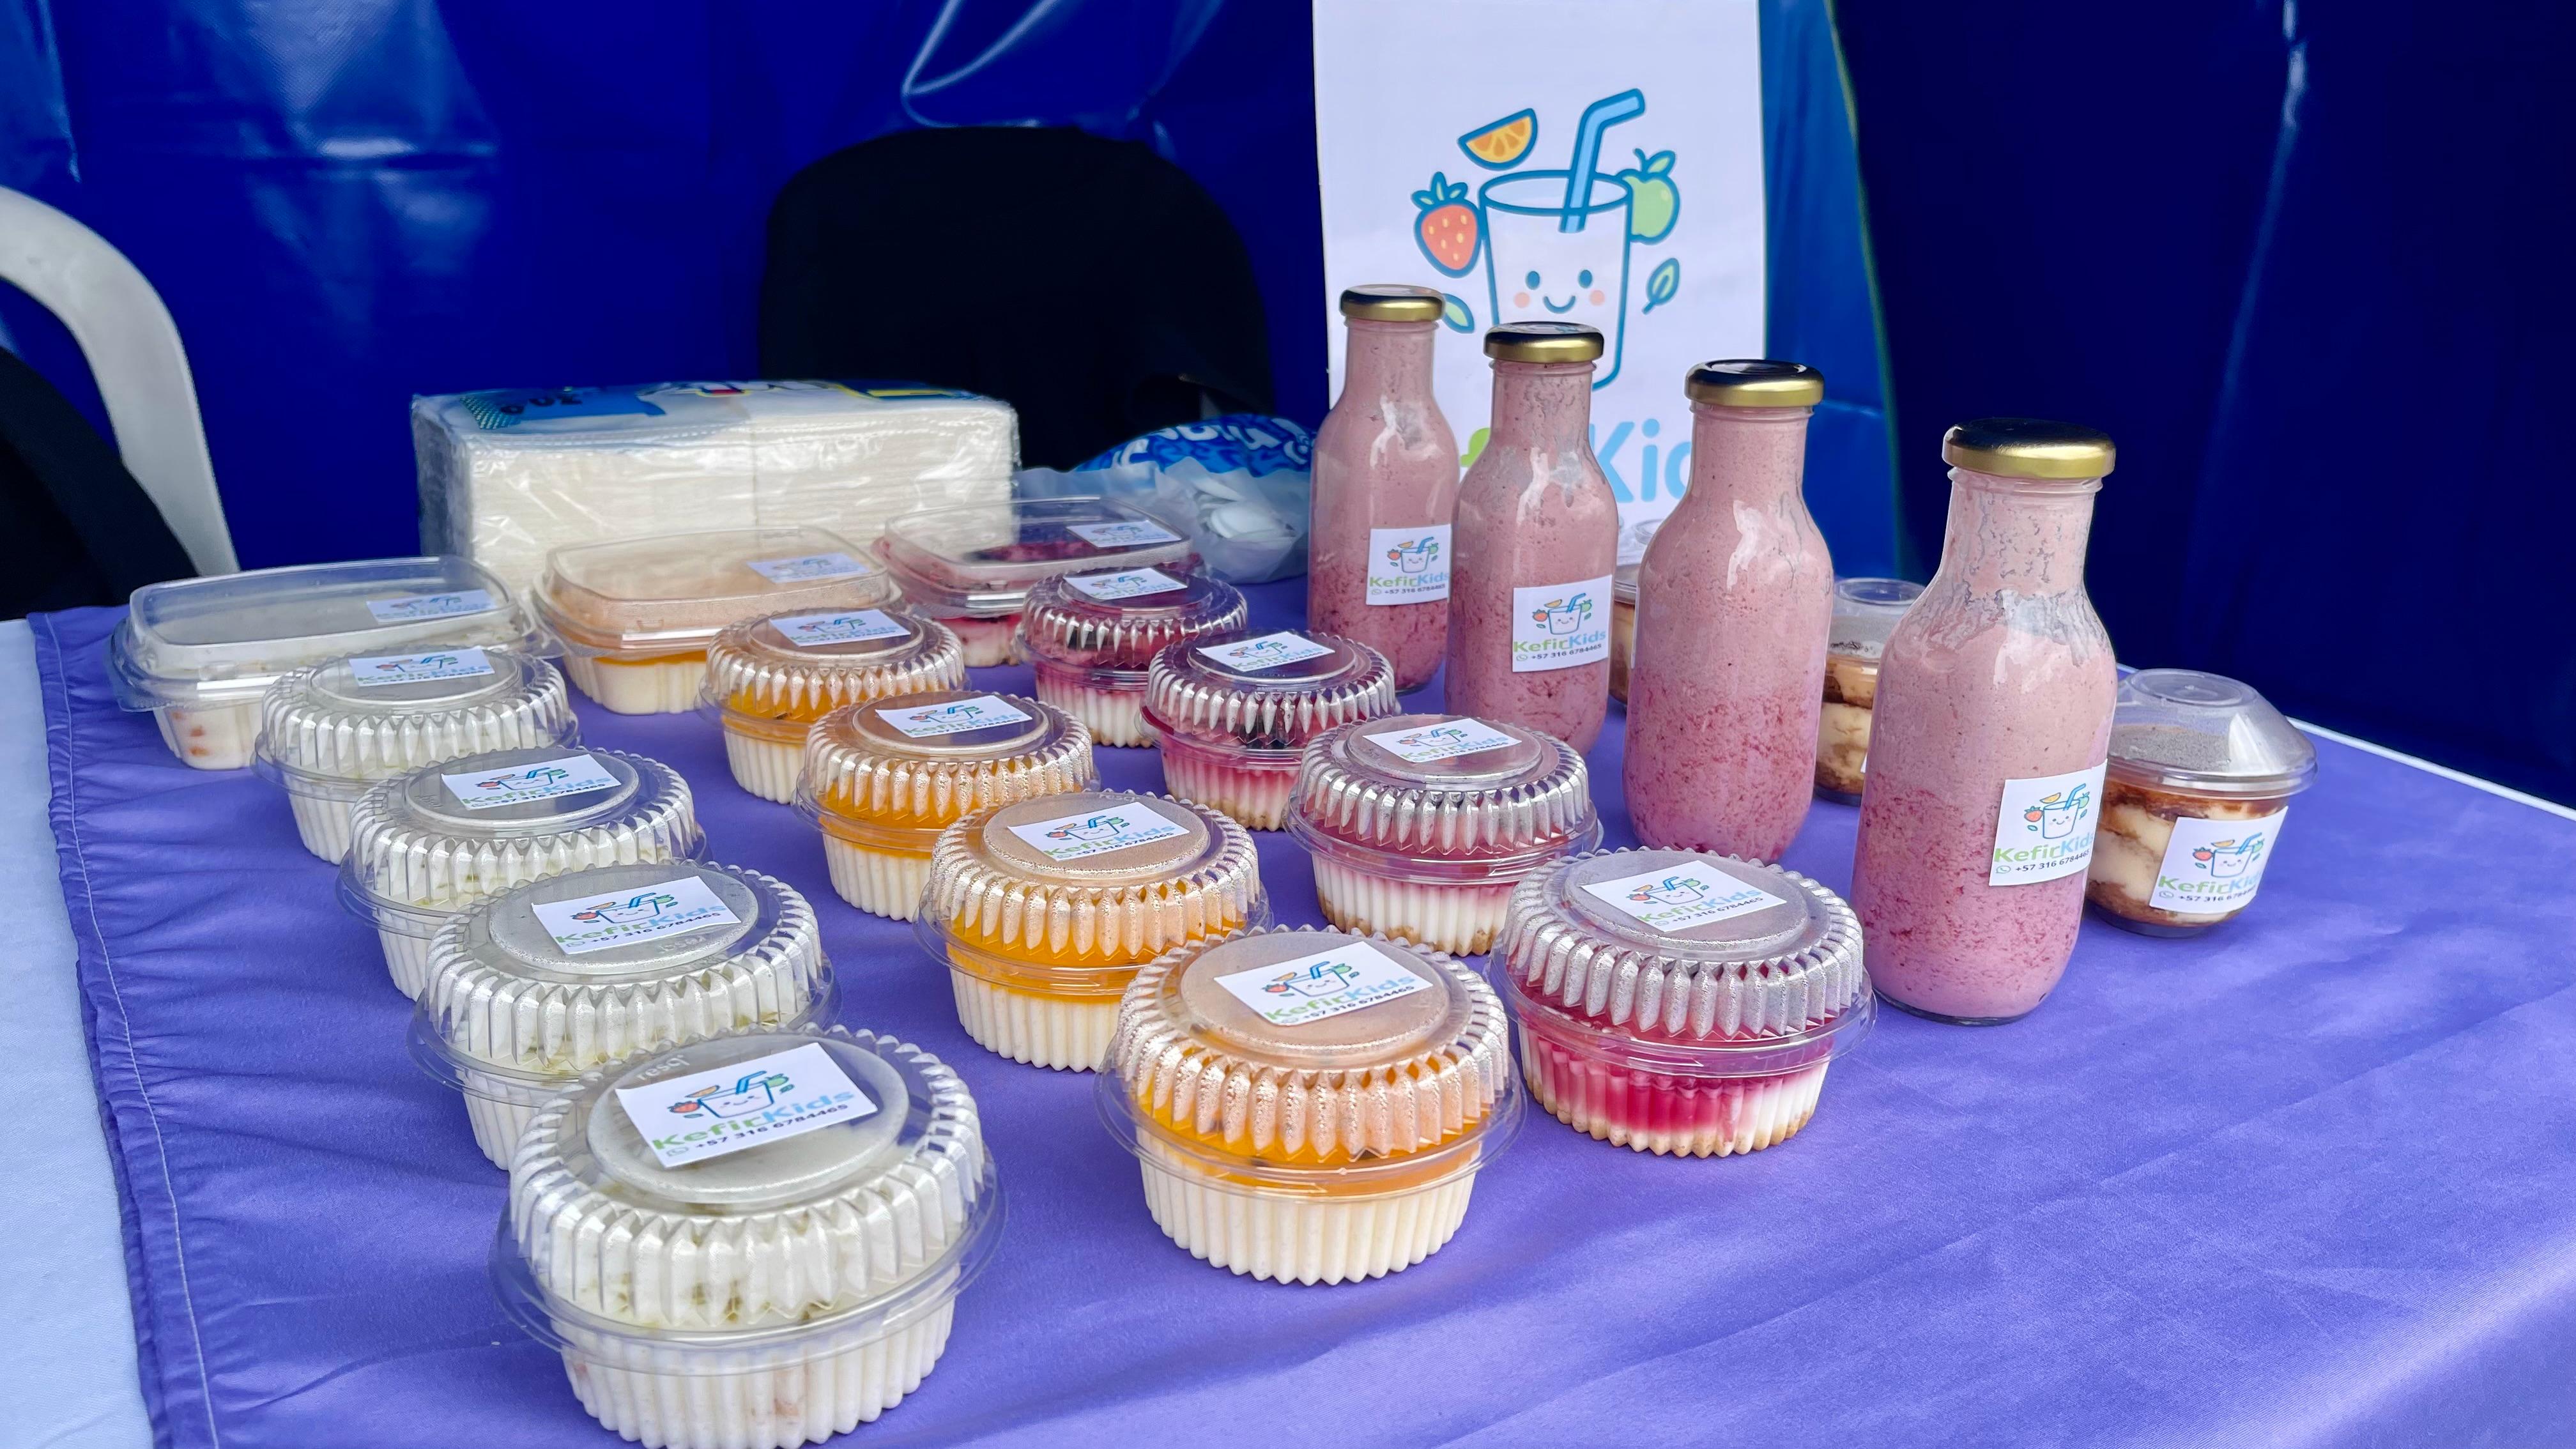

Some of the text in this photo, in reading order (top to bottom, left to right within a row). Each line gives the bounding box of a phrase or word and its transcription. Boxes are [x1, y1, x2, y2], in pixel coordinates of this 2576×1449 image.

[1513, 630, 1606, 652] KefirKids
[463, 778, 610, 804] KefirKids
[1044, 825, 1176, 855] KefirKids
[1636, 889, 1761, 922] KefirKids
[1694, 908, 1716, 917] 316
[555, 904, 726, 944] KefirKids
[625, 928, 652, 938] 316
[1264, 976, 1416, 1020] KefirKids
[1331, 1002, 1356, 1013] 316
[652, 1090, 855, 1150] KefirKids
[696, 1103, 848, 1149] +57 316 6784465
